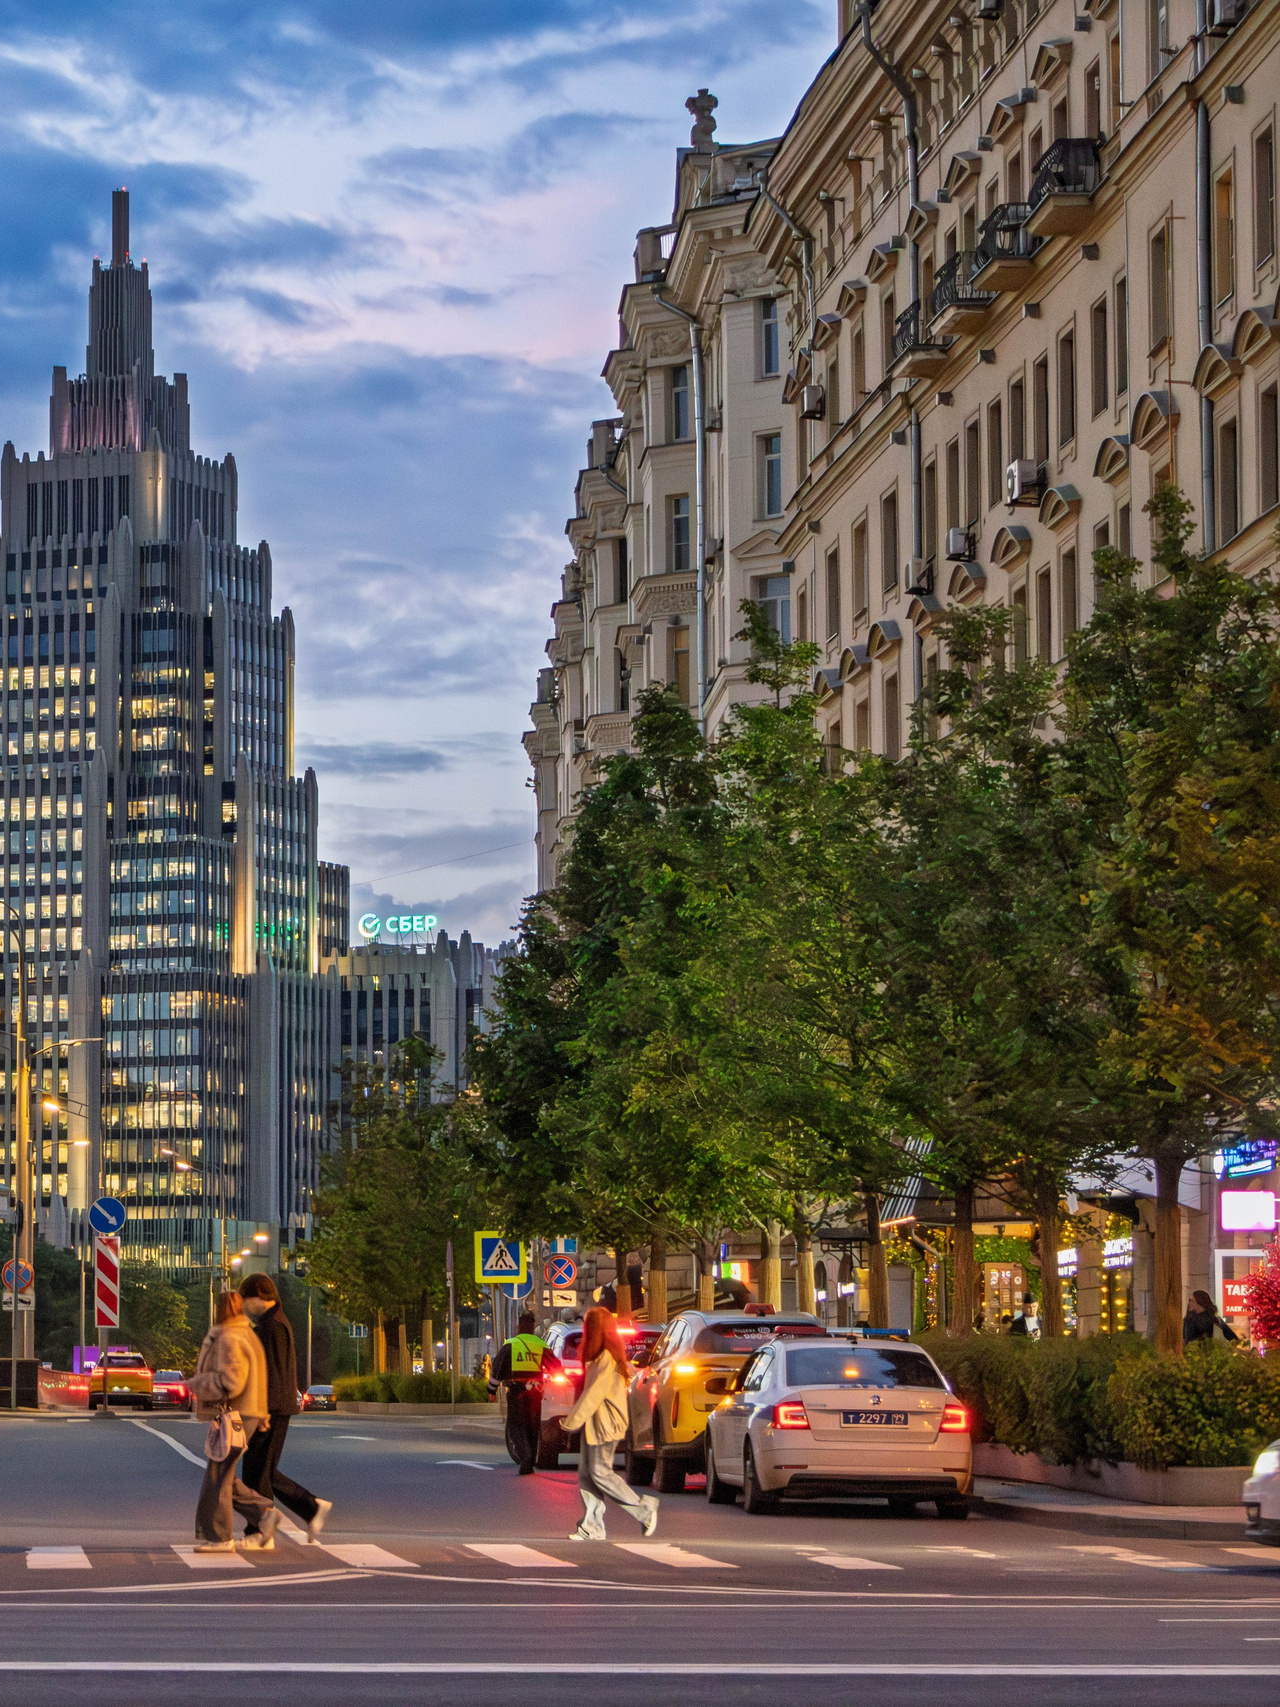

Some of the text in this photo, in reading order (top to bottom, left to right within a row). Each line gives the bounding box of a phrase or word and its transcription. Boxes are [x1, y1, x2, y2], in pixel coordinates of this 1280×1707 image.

[385, 914, 438, 933] СБЕР
[859, 1413, 887, 1424] 2297
[893, 1413, 905, 1422] 99
